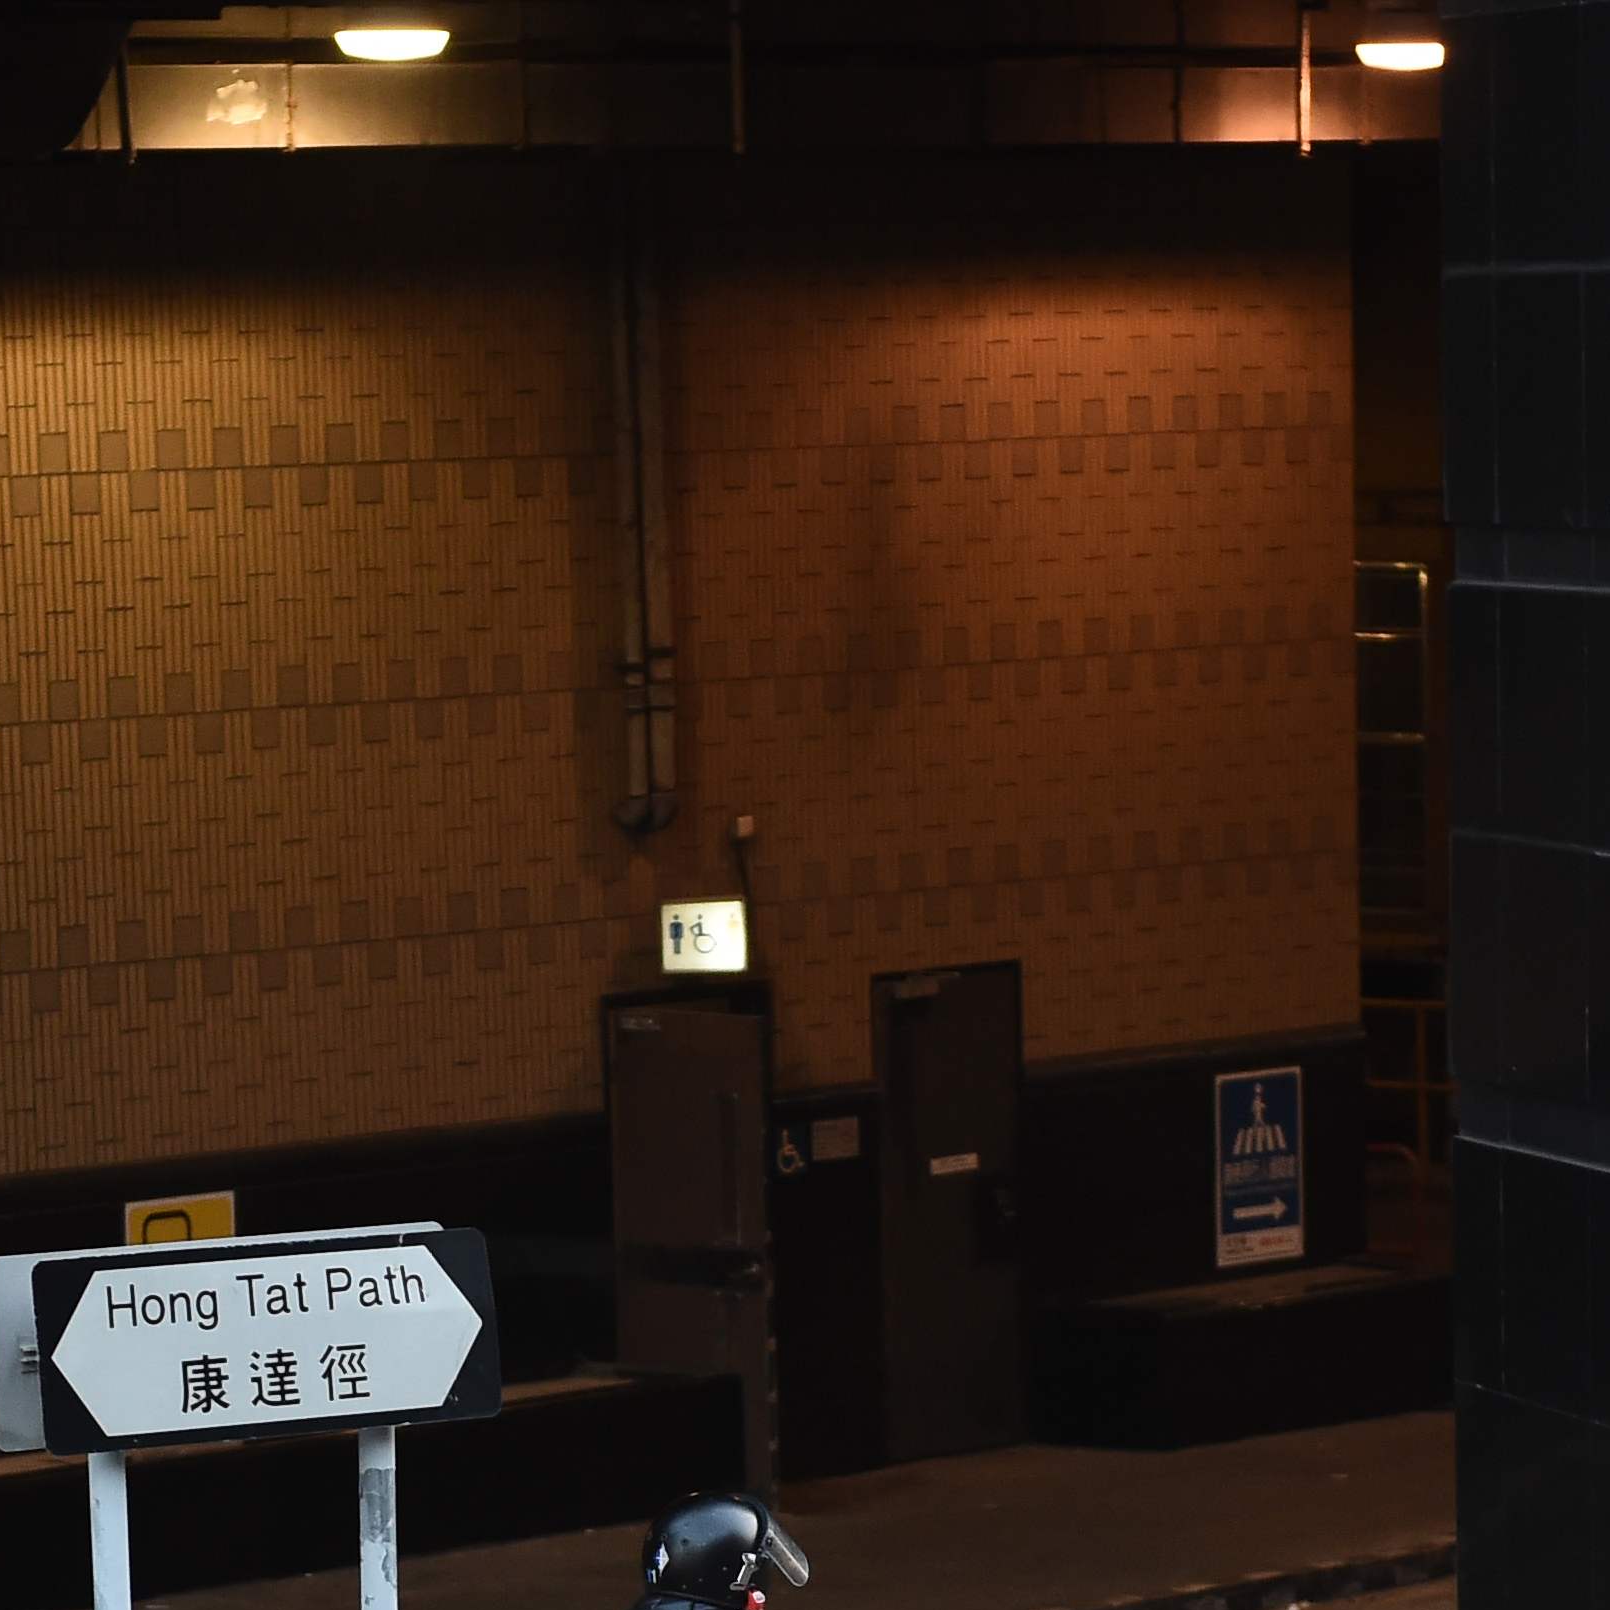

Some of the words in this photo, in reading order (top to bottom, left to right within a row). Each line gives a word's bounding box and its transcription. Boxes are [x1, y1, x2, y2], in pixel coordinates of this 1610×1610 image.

[106, 1284, 220, 1331] Hong
[235, 1272, 310, 1317] Tat
[325, 1265, 427, 1311] Path
[180, 1343, 371, 1415] 康達徑
